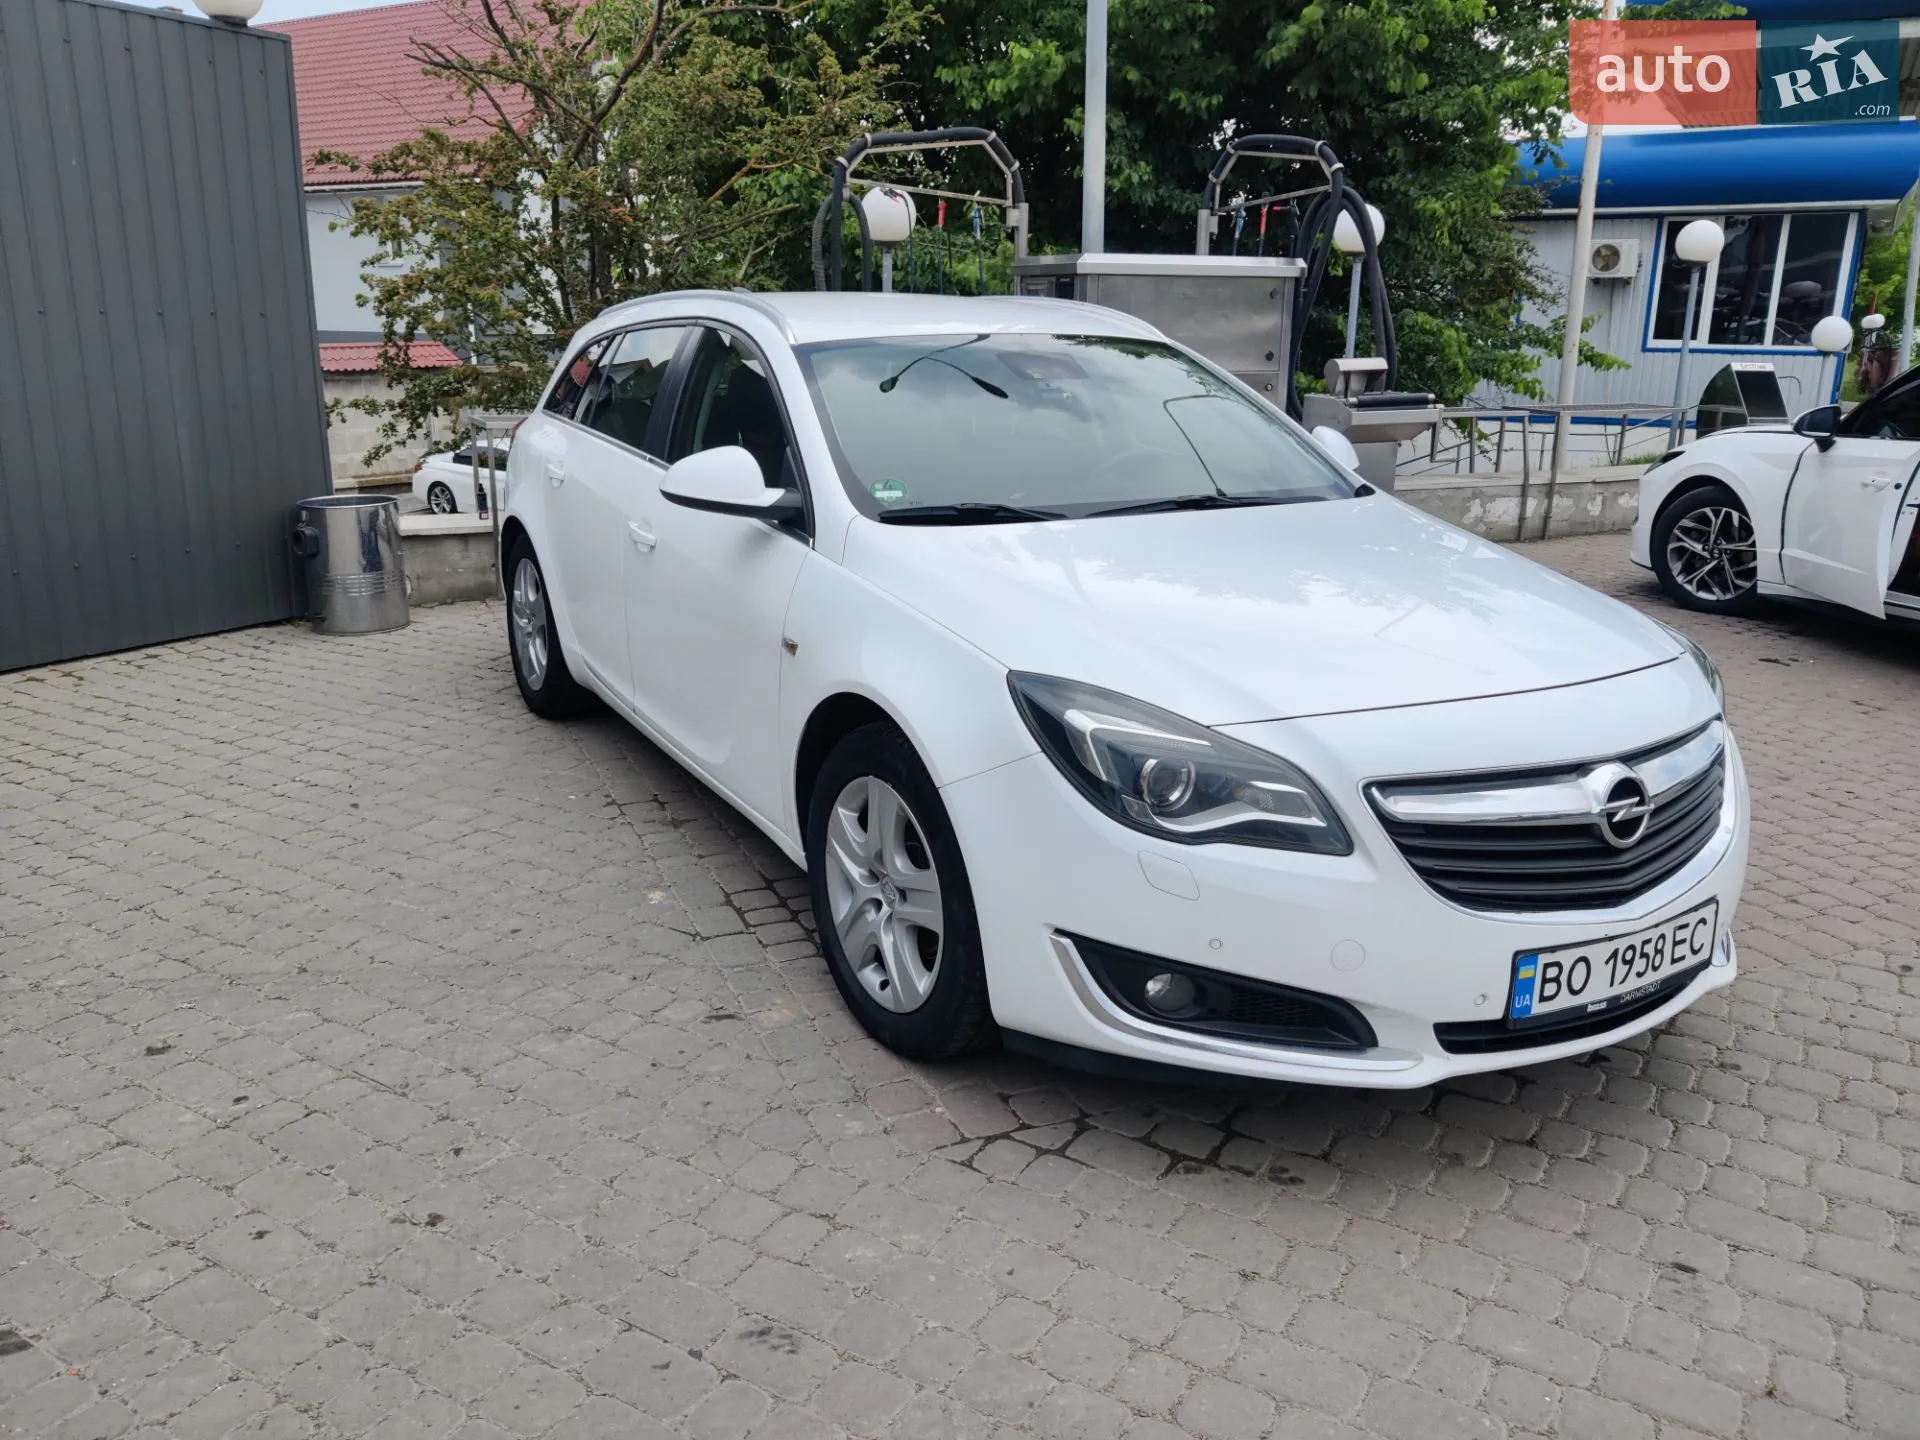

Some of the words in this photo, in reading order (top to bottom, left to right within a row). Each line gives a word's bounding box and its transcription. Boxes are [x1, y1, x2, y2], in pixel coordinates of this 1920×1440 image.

[1537, 956, 1592, 1004] BO
[1604, 932, 1667, 988] 1958
[1670, 916, 1708, 966] EC
[1515, 995, 1532, 1008] UA
